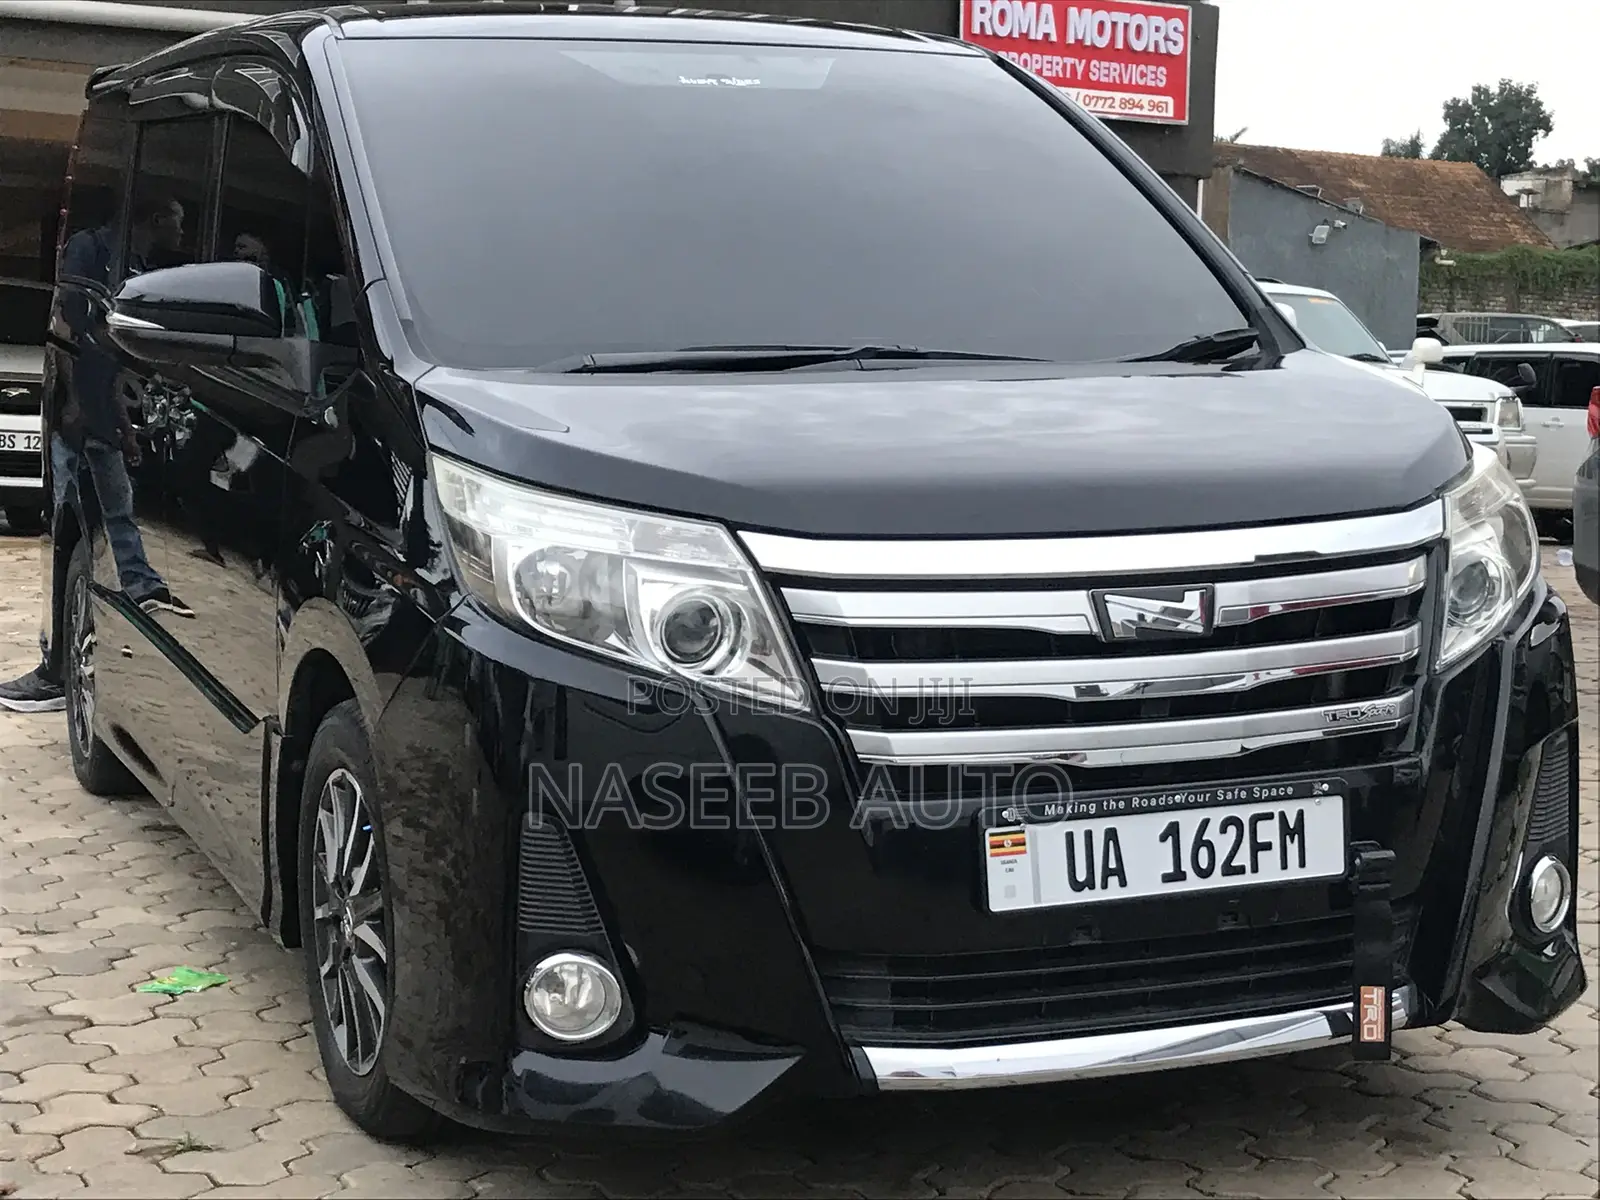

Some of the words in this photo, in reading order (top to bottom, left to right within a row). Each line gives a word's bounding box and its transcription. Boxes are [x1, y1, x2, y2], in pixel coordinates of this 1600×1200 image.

[972, 0, 1057, 42] ROMA
[1066, 7, 1184, 55] MOTORS
[1089, 60, 1167, 88] SERVICES
[1083, 94, 1116, 109] 0772
[1119, 97, 1144, 110] 894
[1147, 100, 1169, 113] 961
[1044, 801, 1097, 816] Making
[1102, 798, 1126, 811] the
[1217, 788, 1247, 800] Safe
[1253, 786, 1294, 800] Space
[1064, 827, 1128, 893] UA
[1158, 808, 1306, 884] 162FM
